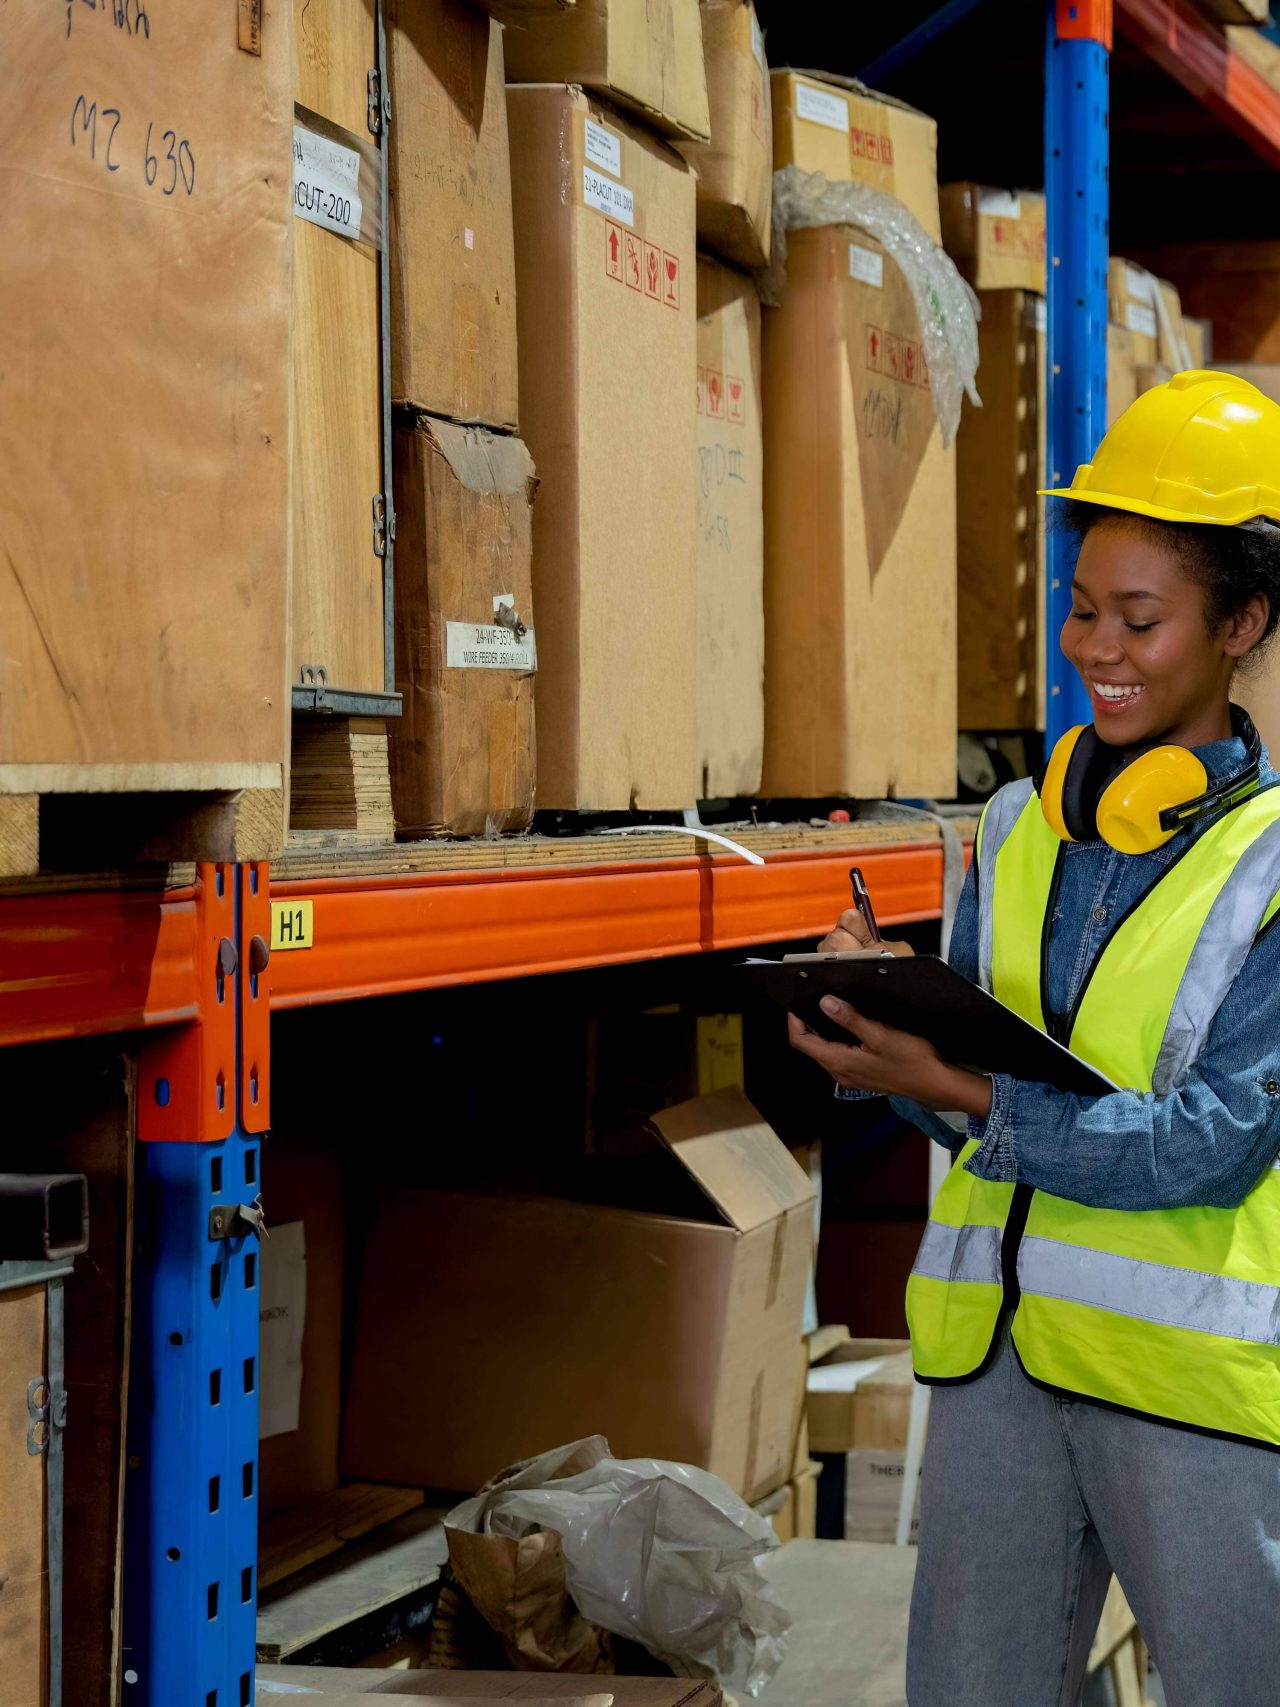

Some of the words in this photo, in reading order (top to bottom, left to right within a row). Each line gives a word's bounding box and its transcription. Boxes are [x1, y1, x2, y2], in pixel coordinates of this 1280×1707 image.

[144, 121, 195, 196] 630
[463, 651, 478, 664] WIRE
[479, 651, 498, 664] FEEDER
[280, 910, 304, 942] H1
[868, 1463, 905, 1476] THER
